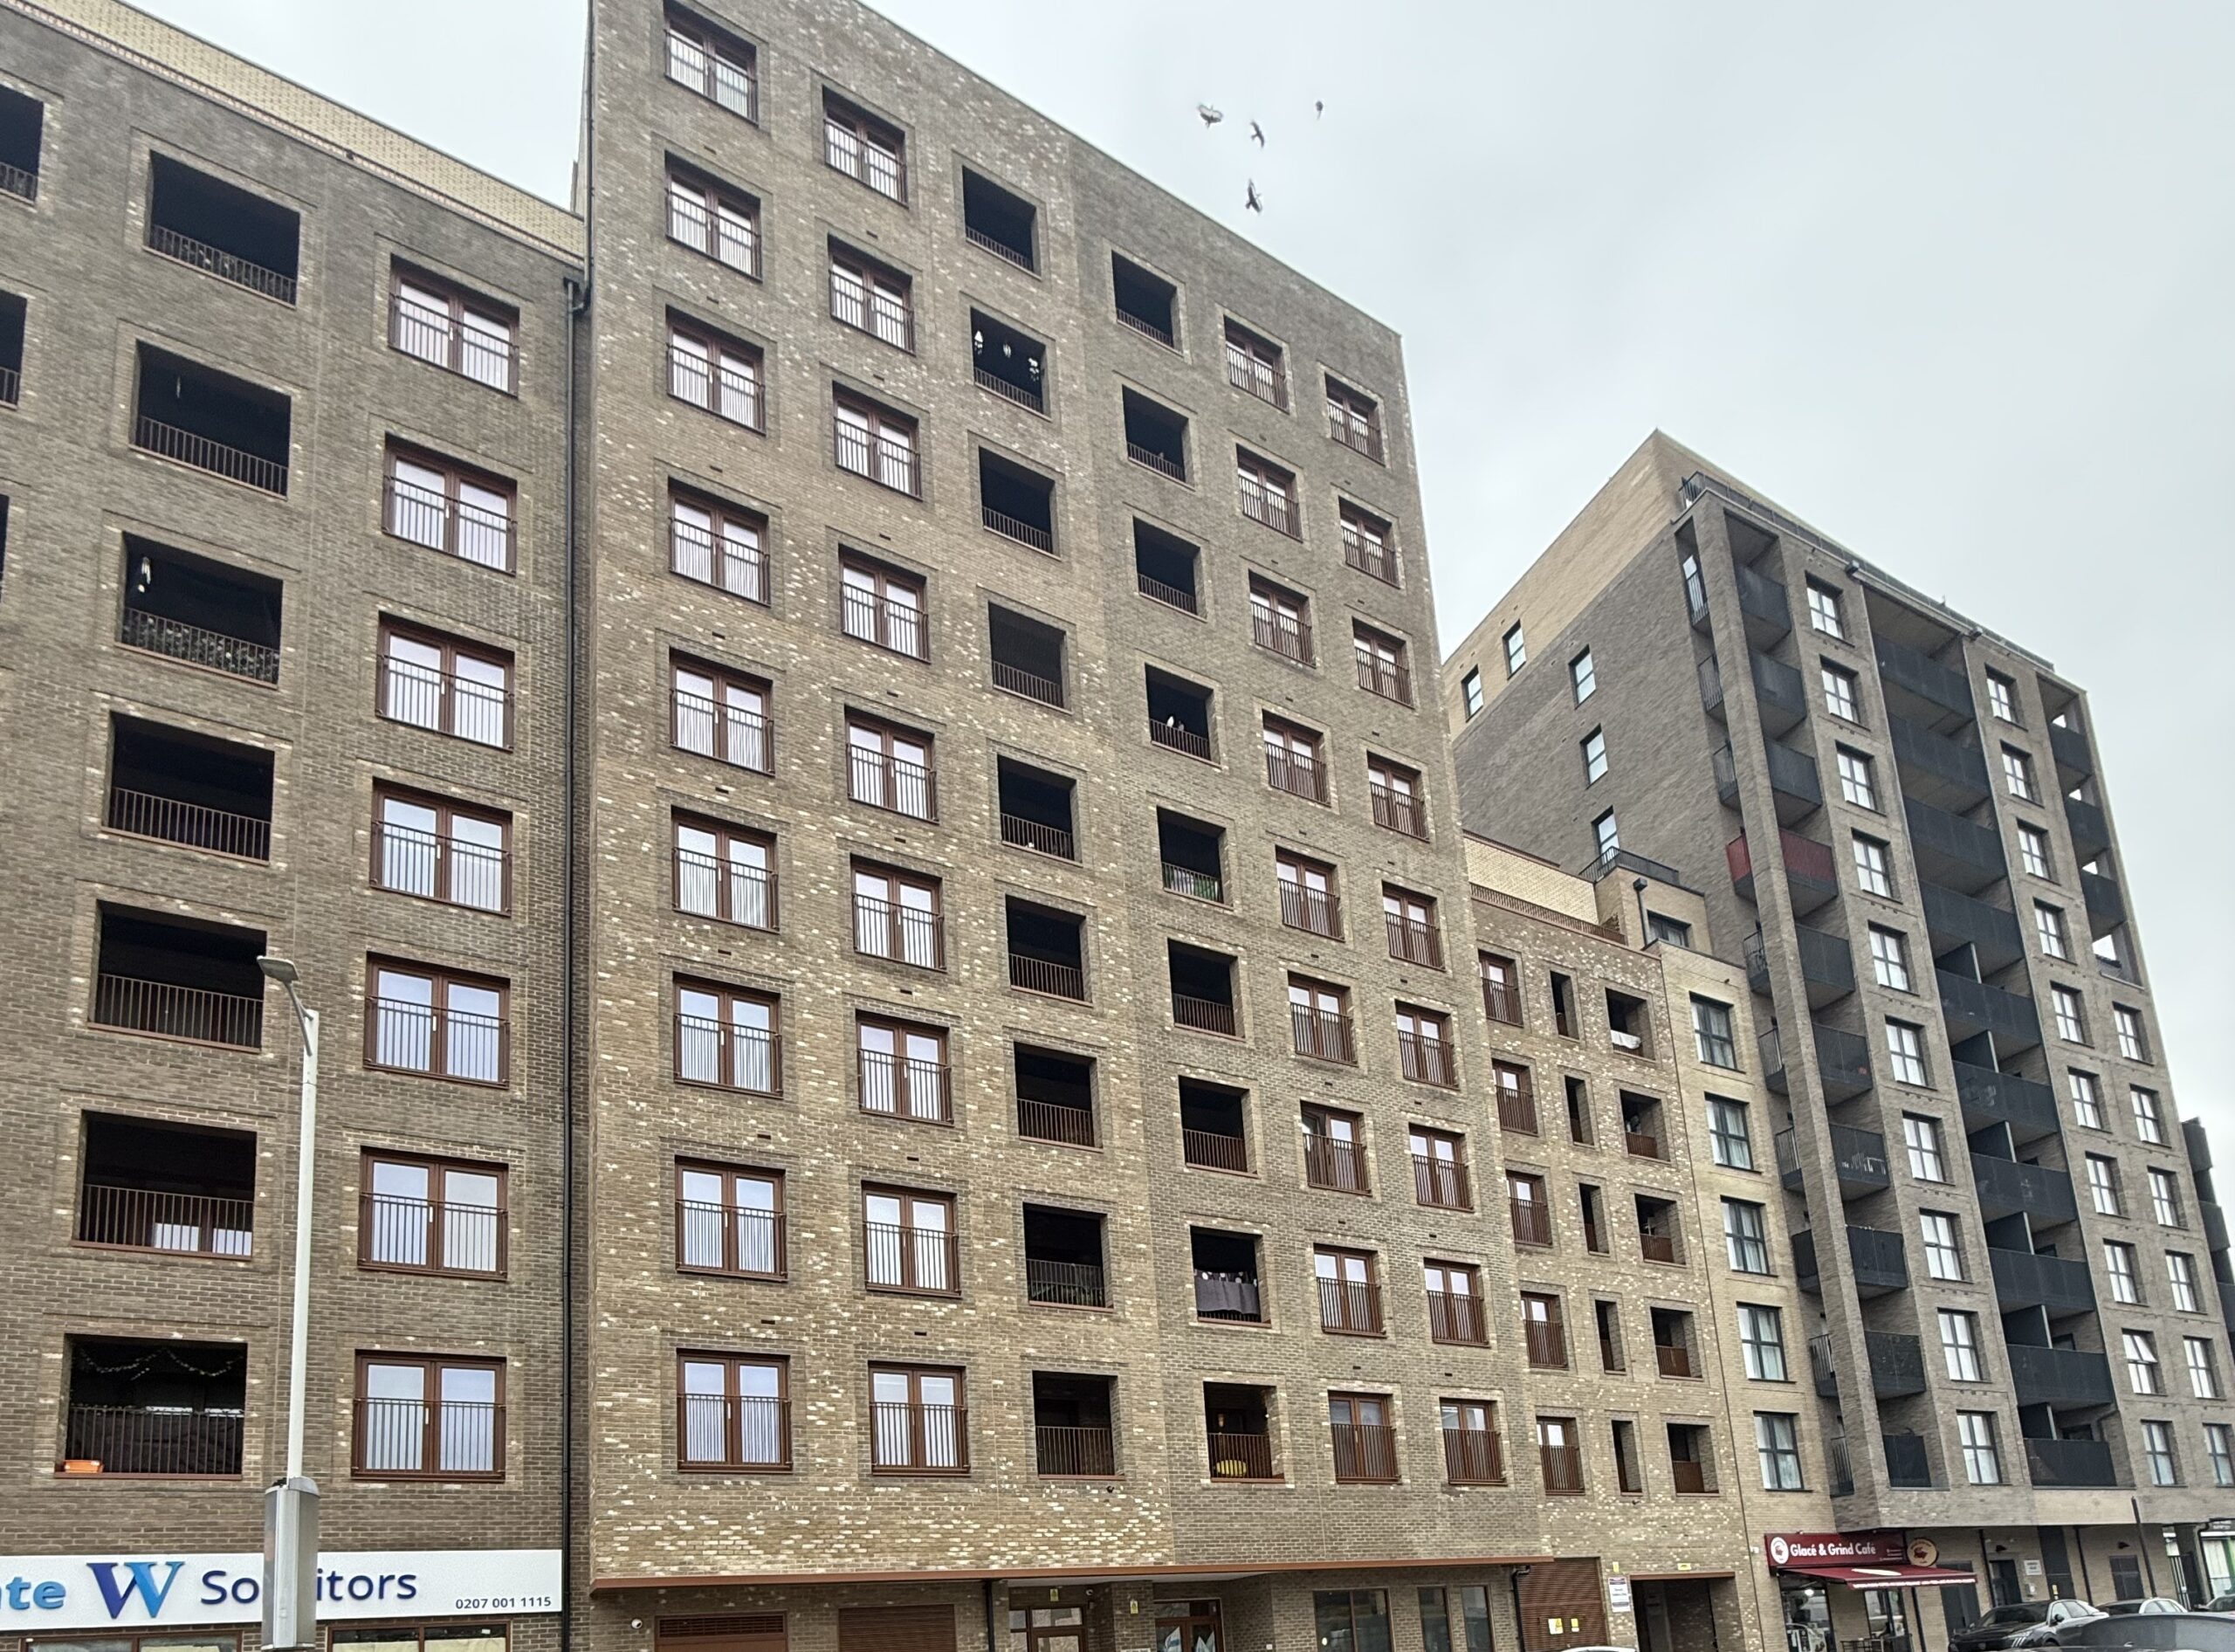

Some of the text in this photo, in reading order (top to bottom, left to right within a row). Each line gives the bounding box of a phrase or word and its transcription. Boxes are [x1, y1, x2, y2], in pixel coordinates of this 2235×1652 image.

[1790, 1541, 1876, 1556] Glacé & Grind Café
[0, 1561, 417, 1619] te W Soitors
[455, 1596, 552, 1609] 0207 001 1115
